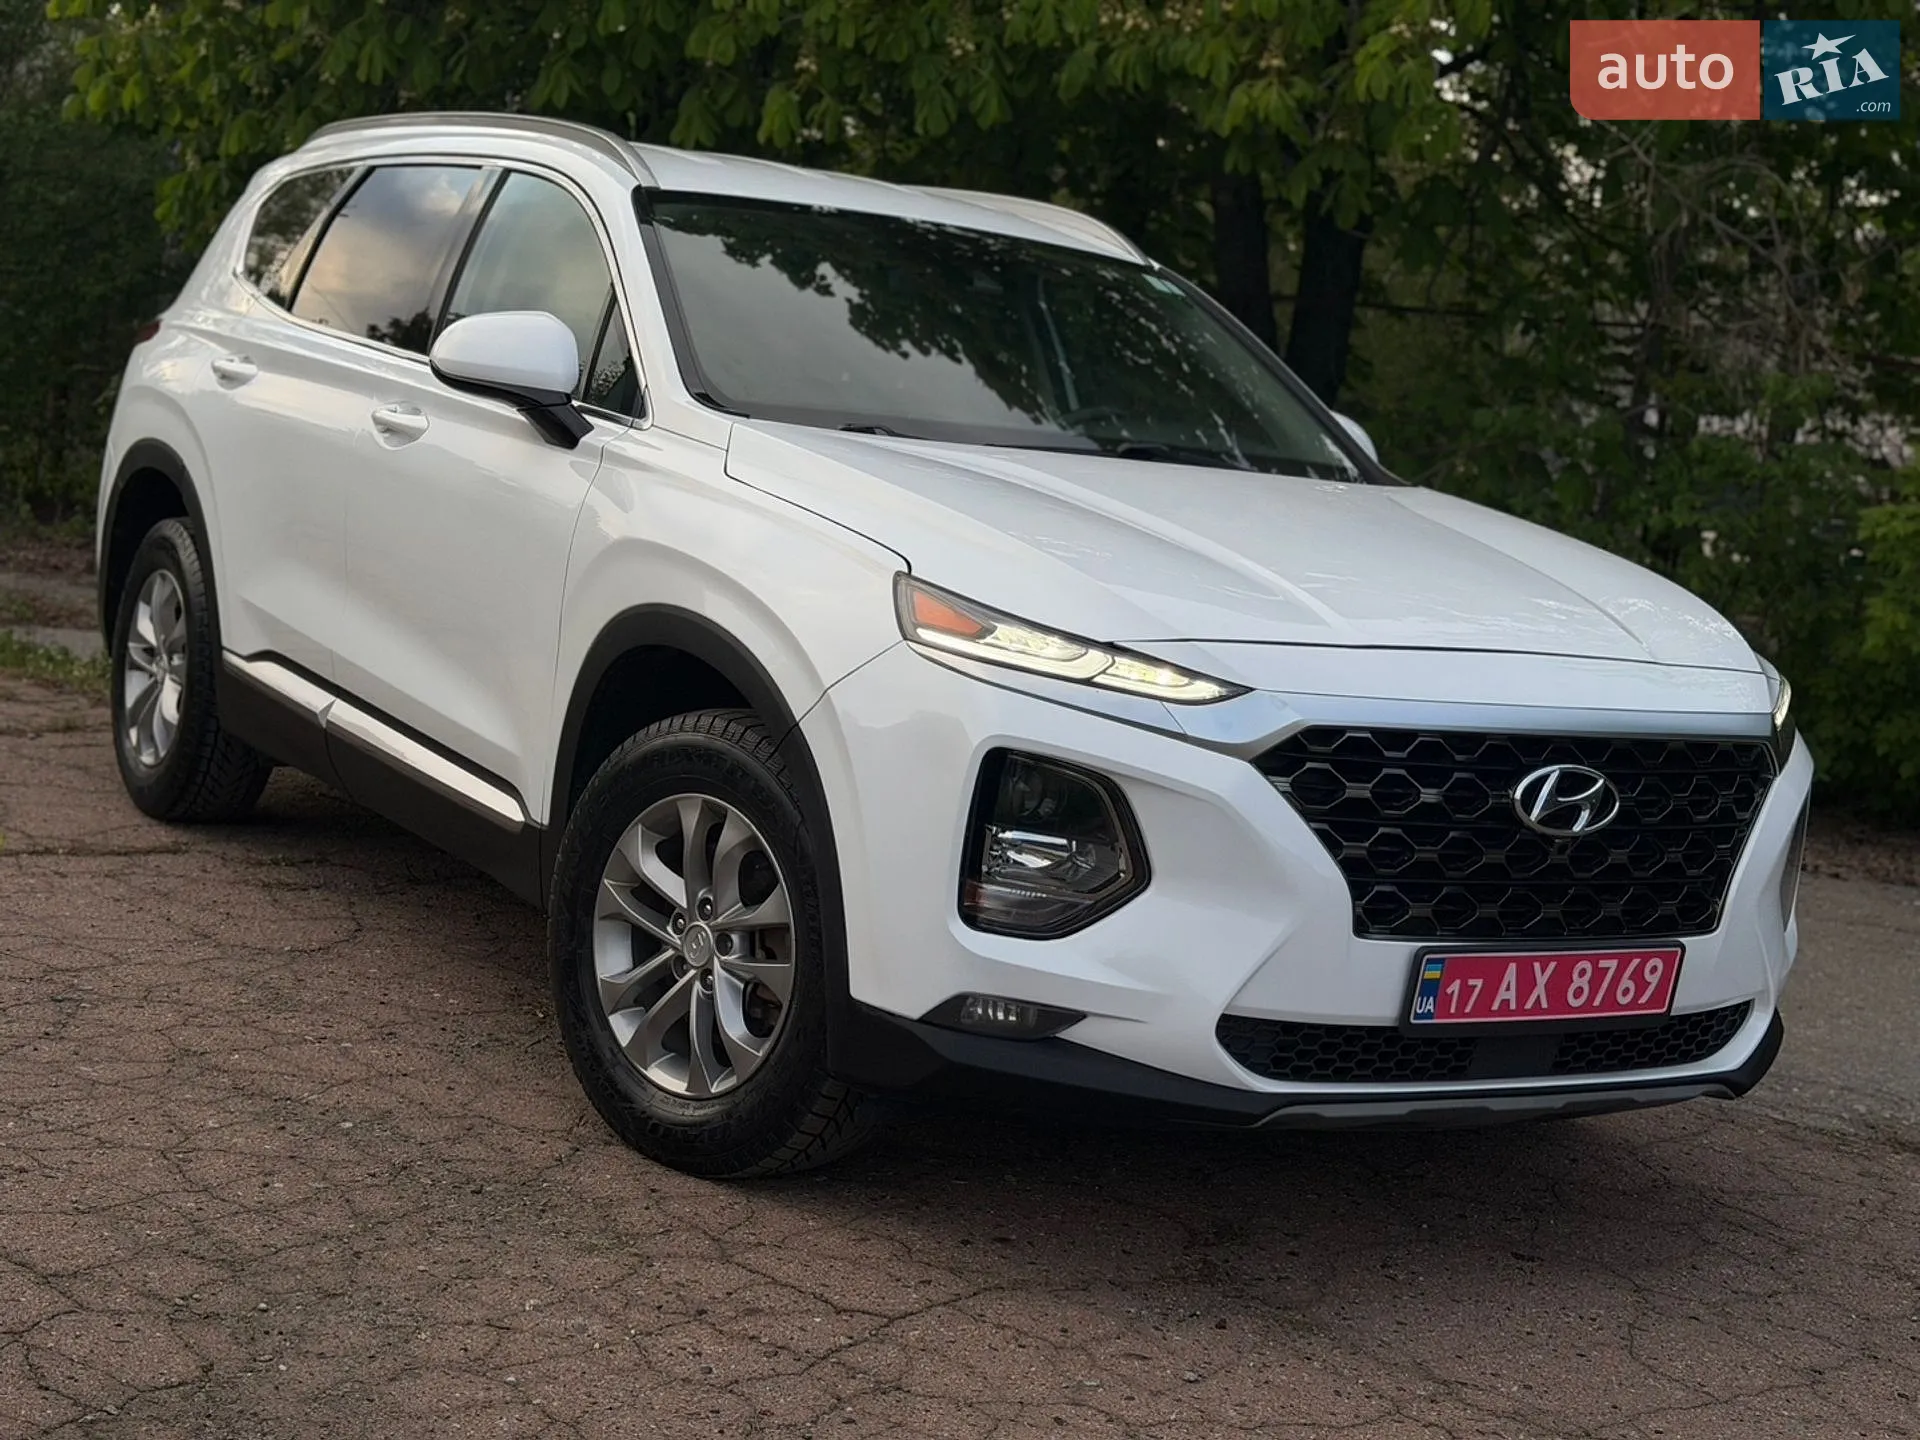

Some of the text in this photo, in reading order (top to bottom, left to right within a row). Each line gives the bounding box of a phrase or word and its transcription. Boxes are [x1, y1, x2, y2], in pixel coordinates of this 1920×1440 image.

[1445, 957, 1664, 1013] 17 AX 8769
[1416, 996, 1435, 1014] UA
